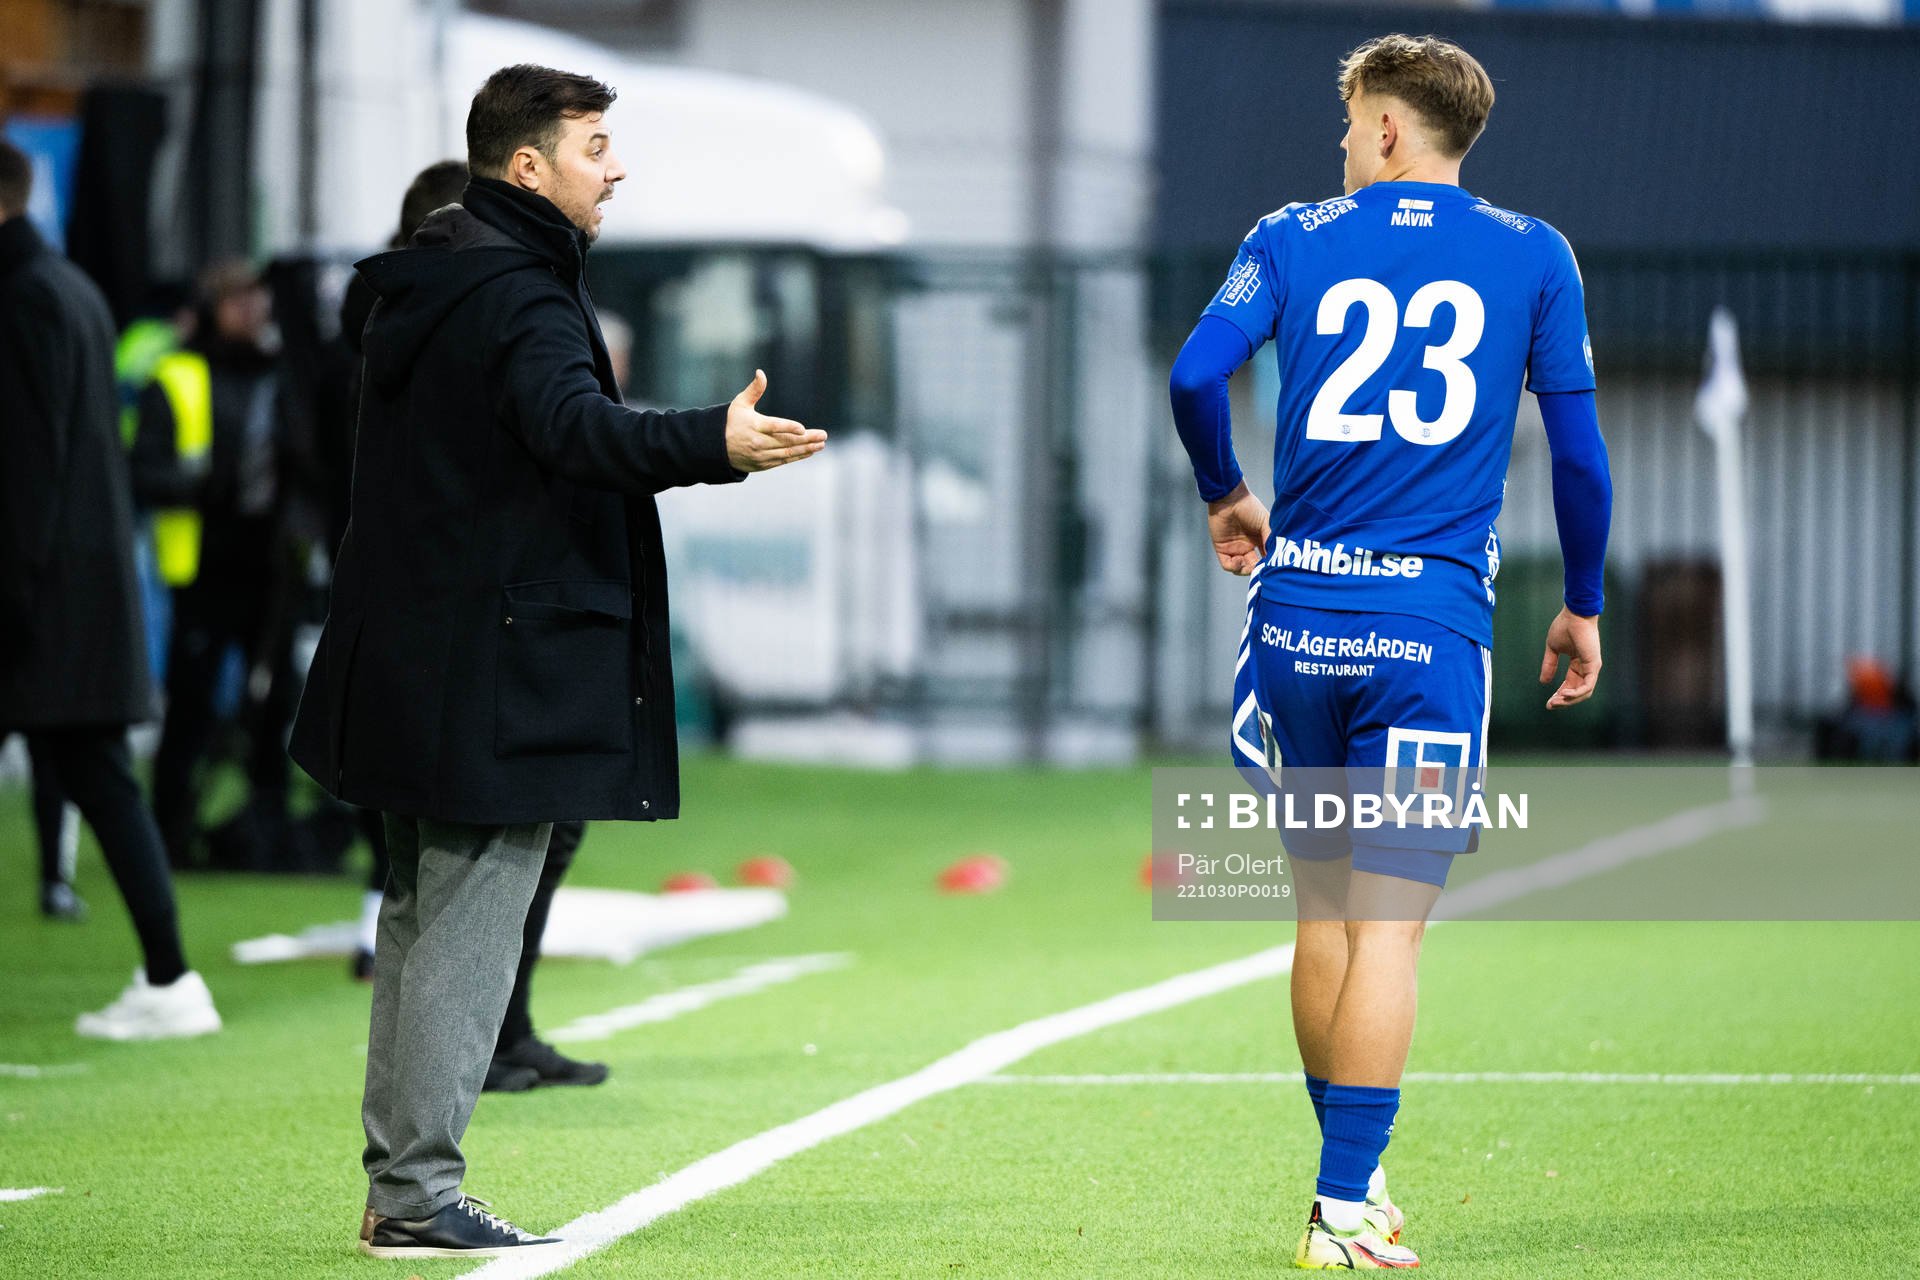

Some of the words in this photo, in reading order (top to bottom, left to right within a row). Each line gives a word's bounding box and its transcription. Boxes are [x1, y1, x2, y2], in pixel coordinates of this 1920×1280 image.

[1391, 208, 1435, 227] NÅVIK
[1306, 278, 1485, 446] 23
[1261, 623, 1433, 664] SCHLÄGERGÅRDEN
[1294, 660, 1375, 677] RESTAURANT
